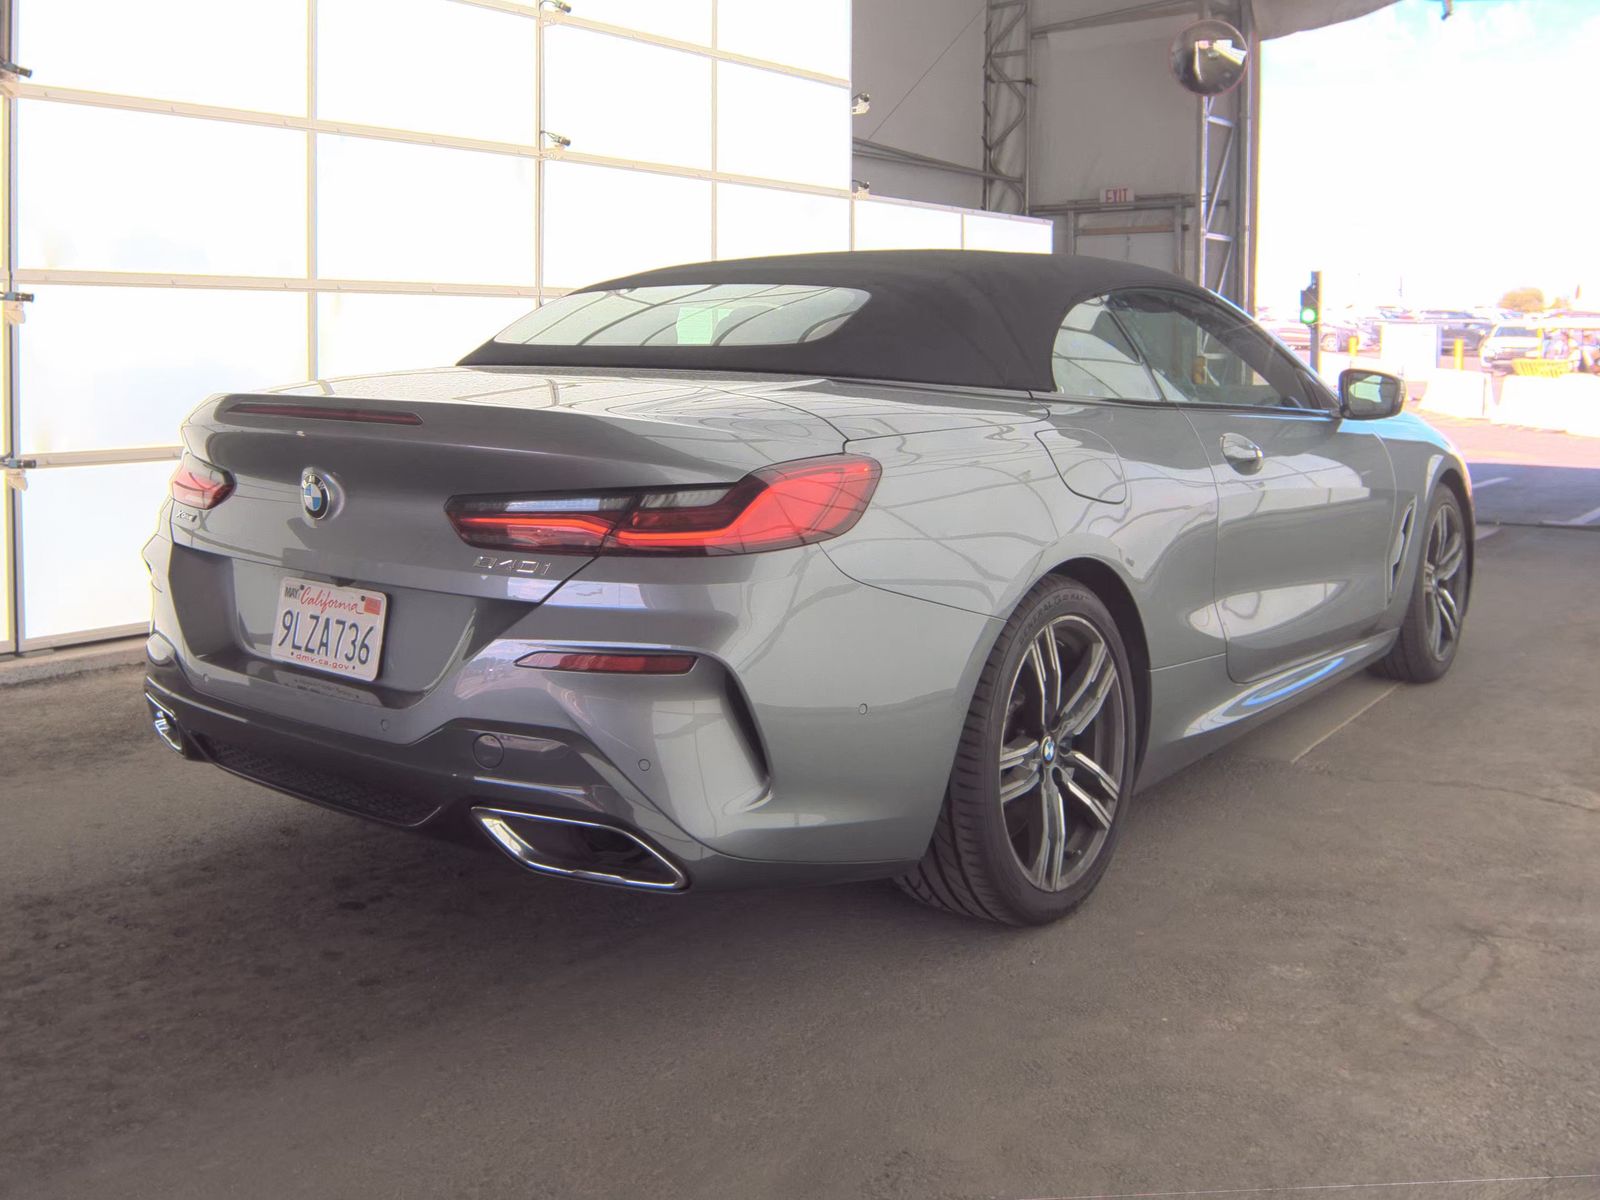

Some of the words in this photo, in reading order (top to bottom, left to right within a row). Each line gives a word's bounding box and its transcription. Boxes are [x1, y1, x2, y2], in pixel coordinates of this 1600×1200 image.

[1105, 187, 1128, 204] EXIT
[285, 586, 300, 599] MAY
[300, 586, 364, 614] California
[278, 608, 374, 665] 9LZA736
[295, 652, 350, 671] dmv.ca.gov
